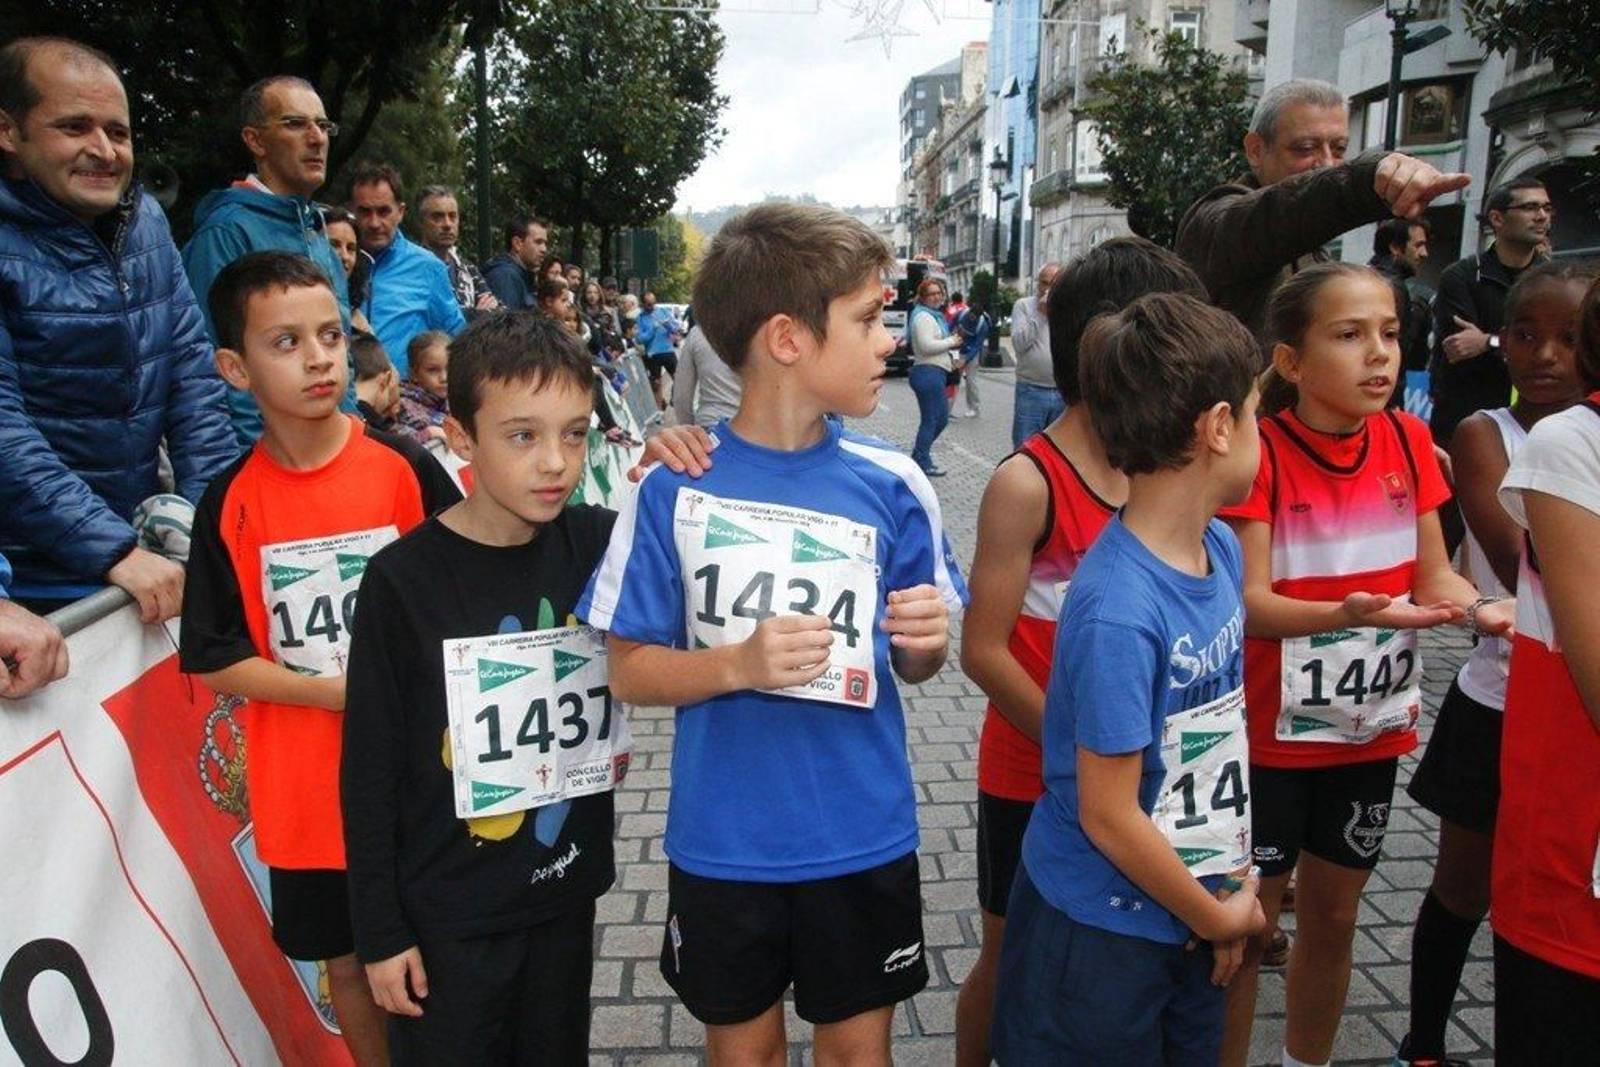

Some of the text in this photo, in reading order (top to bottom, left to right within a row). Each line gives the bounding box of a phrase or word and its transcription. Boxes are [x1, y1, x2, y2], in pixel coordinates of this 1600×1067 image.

[694, 563, 860, 648] 1434
[810, 680, 835, 691] VIGO
[1301, 649, 1414, 706] 1442
[475, 685, 613, 763] 1437
[566, 763, 611, 779] CONCELLO
[572, 779, 584, 787] DE
